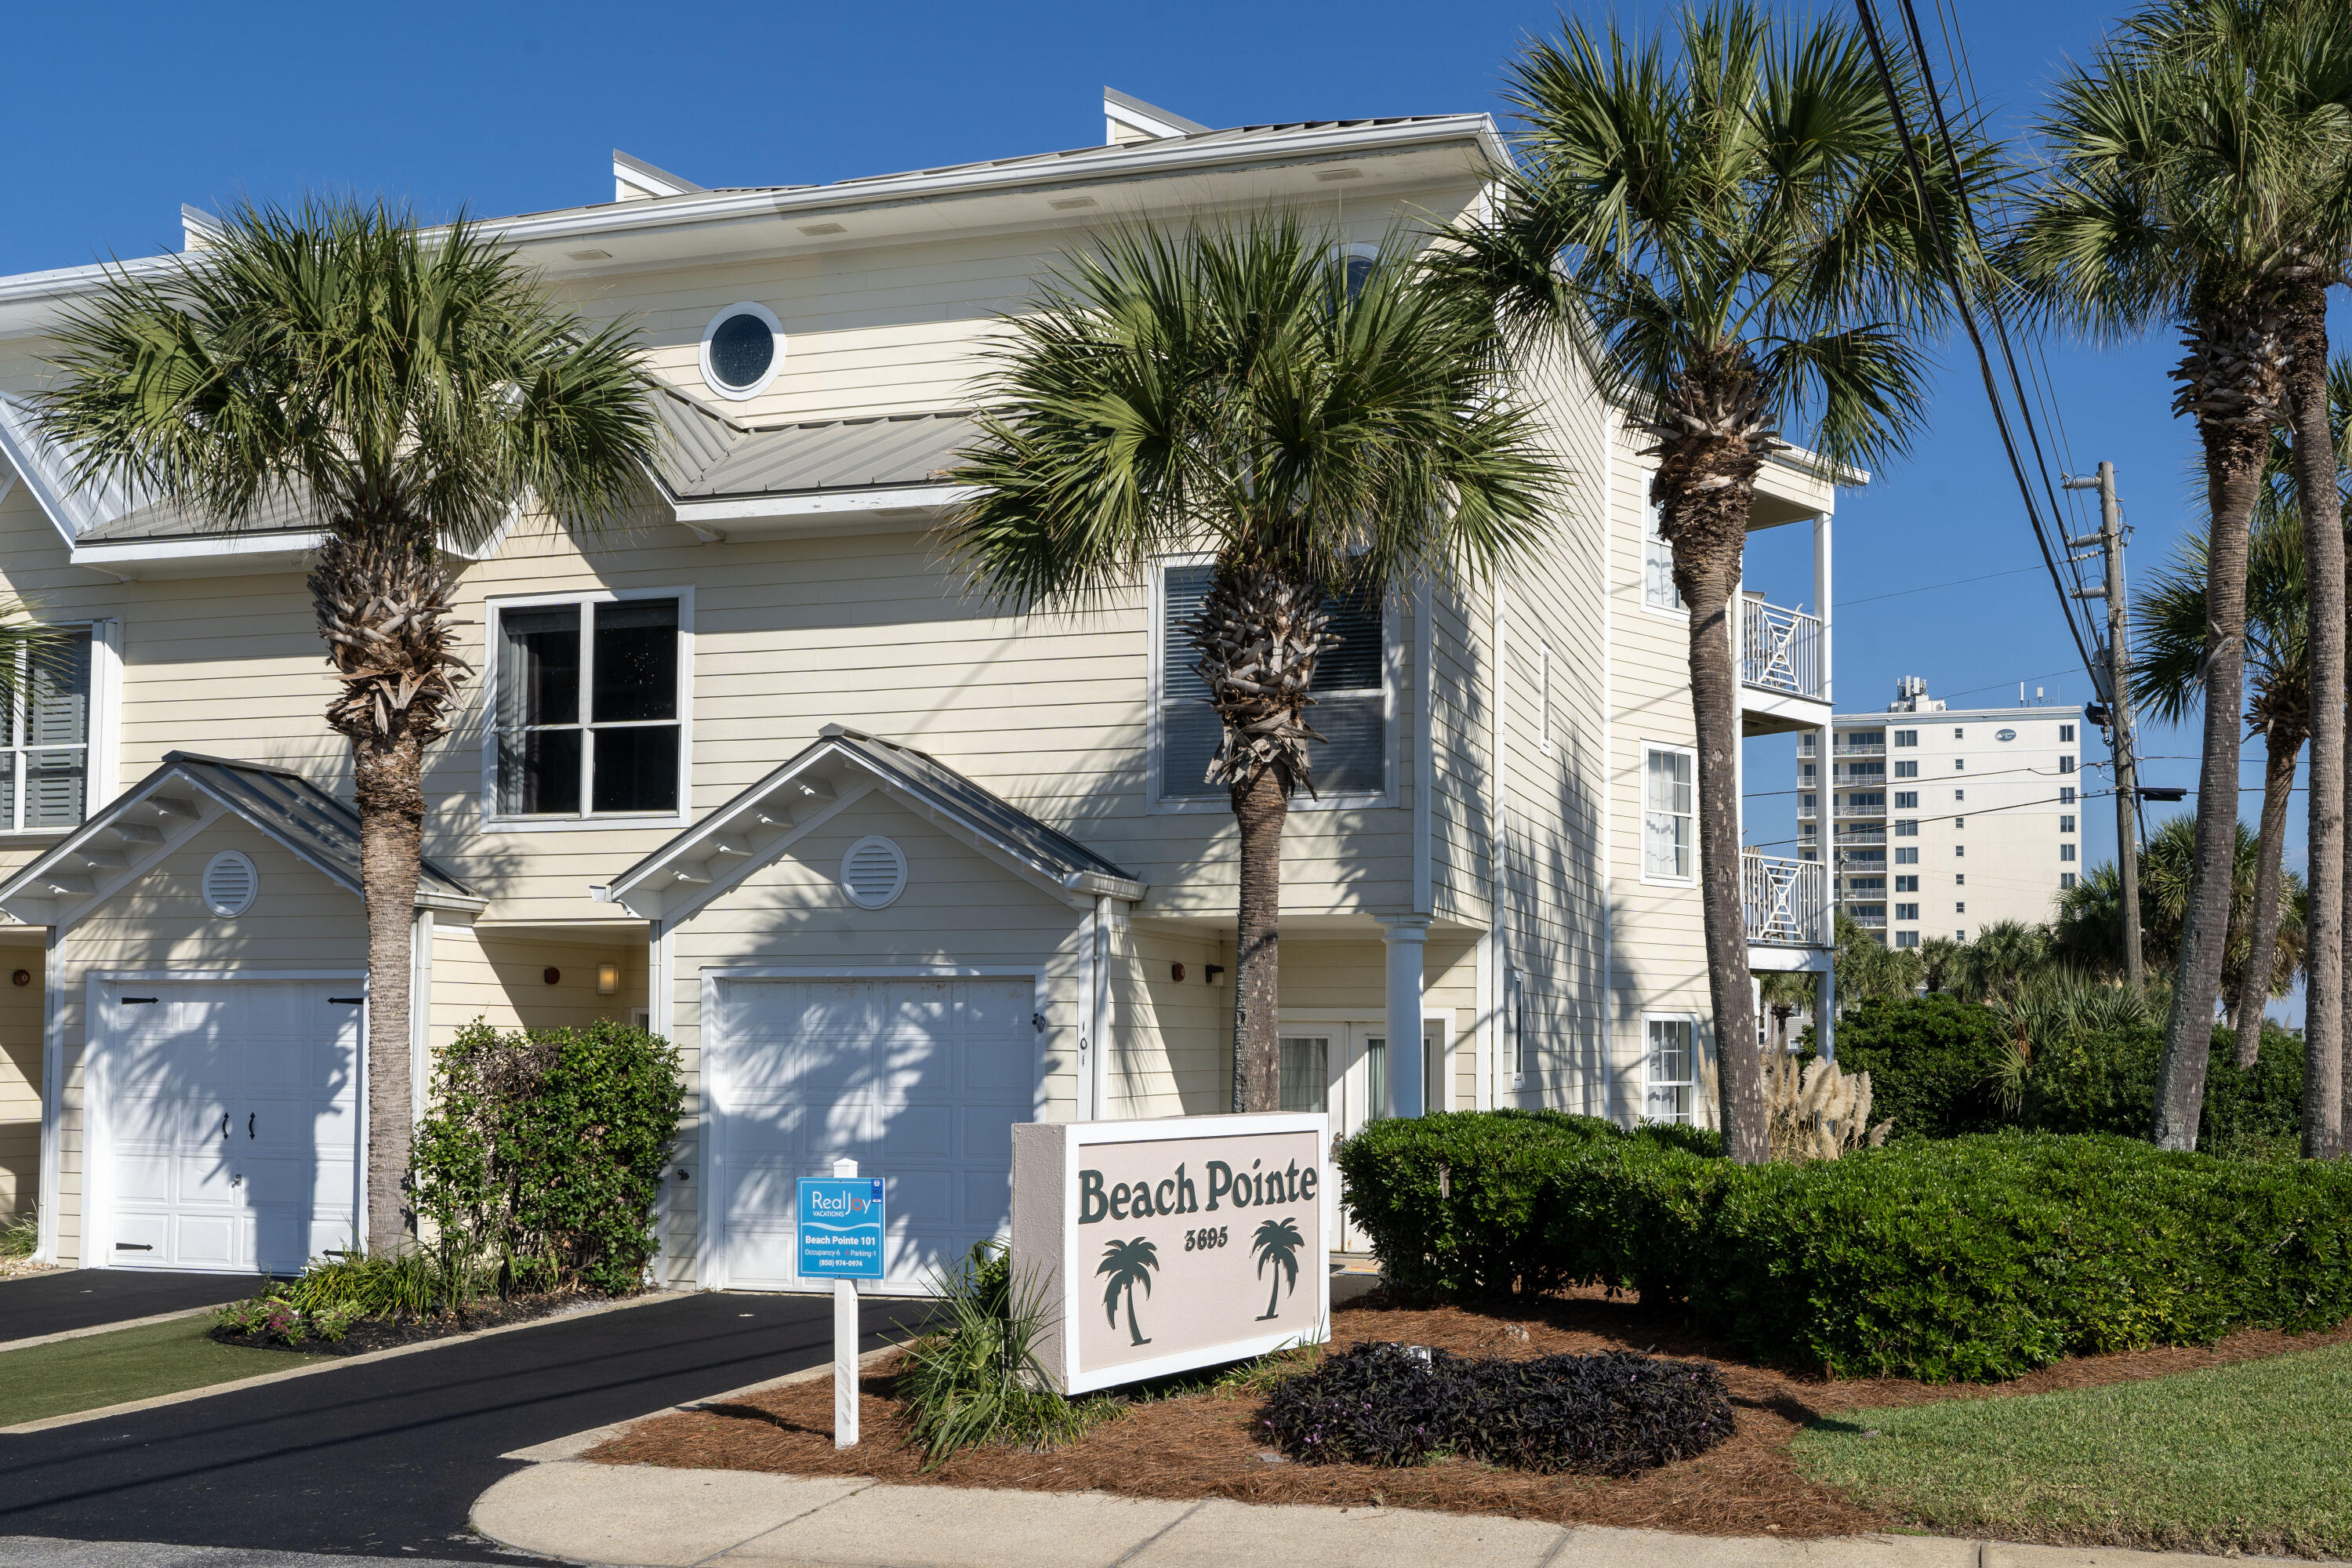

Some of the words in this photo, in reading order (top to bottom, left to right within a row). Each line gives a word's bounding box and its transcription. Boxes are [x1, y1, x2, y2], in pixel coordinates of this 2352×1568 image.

[1078, 1161, 1199, 1225] Beach
[1205, 1157, 1318, 1211] Pointe
[805, 1236, 830, 1244] Beach
[832, 1236, 859, 1245] Pointe
[860, 1236, 876, 1246] 101
[1184, 1225, 1229, 1252] 3695
[804, 1248, 840, 1257] Occupancy-6
[851, 1250, 877, 1258] Parking-1
